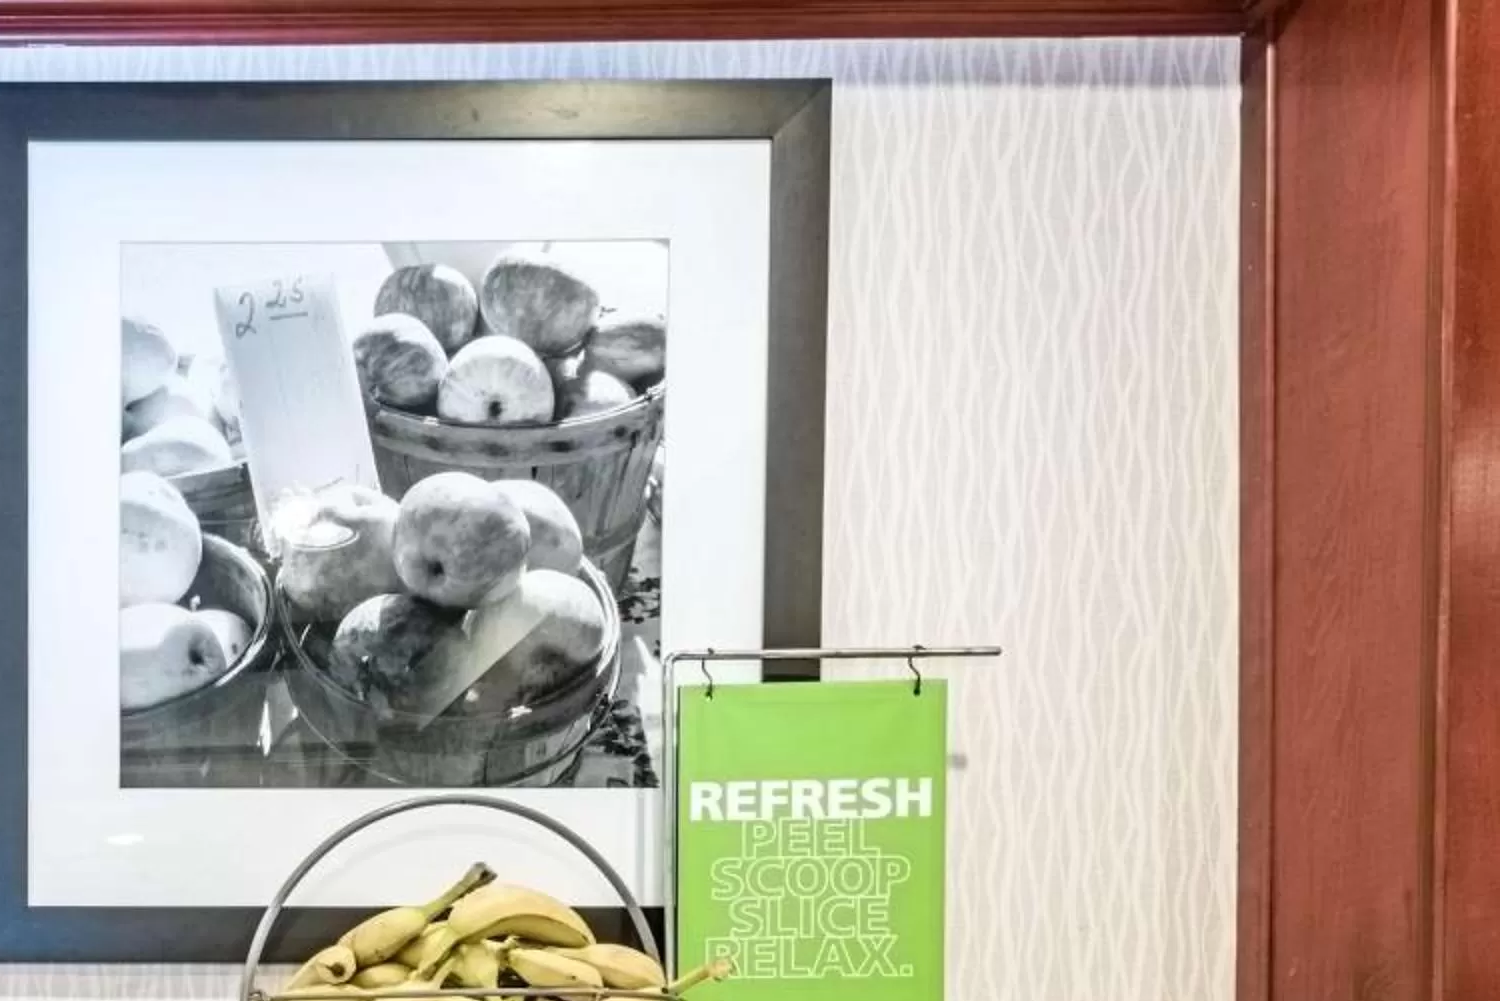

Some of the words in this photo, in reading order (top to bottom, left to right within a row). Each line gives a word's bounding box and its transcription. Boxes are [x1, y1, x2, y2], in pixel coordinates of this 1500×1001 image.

[235, 291, 257, 339] 2
[689, 777, 933, 821] REFRESH
[741, 816, 881, 860] PEEL
[710, 855, 912, 900] SCOOP
[728, 895, 892, 939] SLICE
[705, 934, 913, 978] RELAX.
